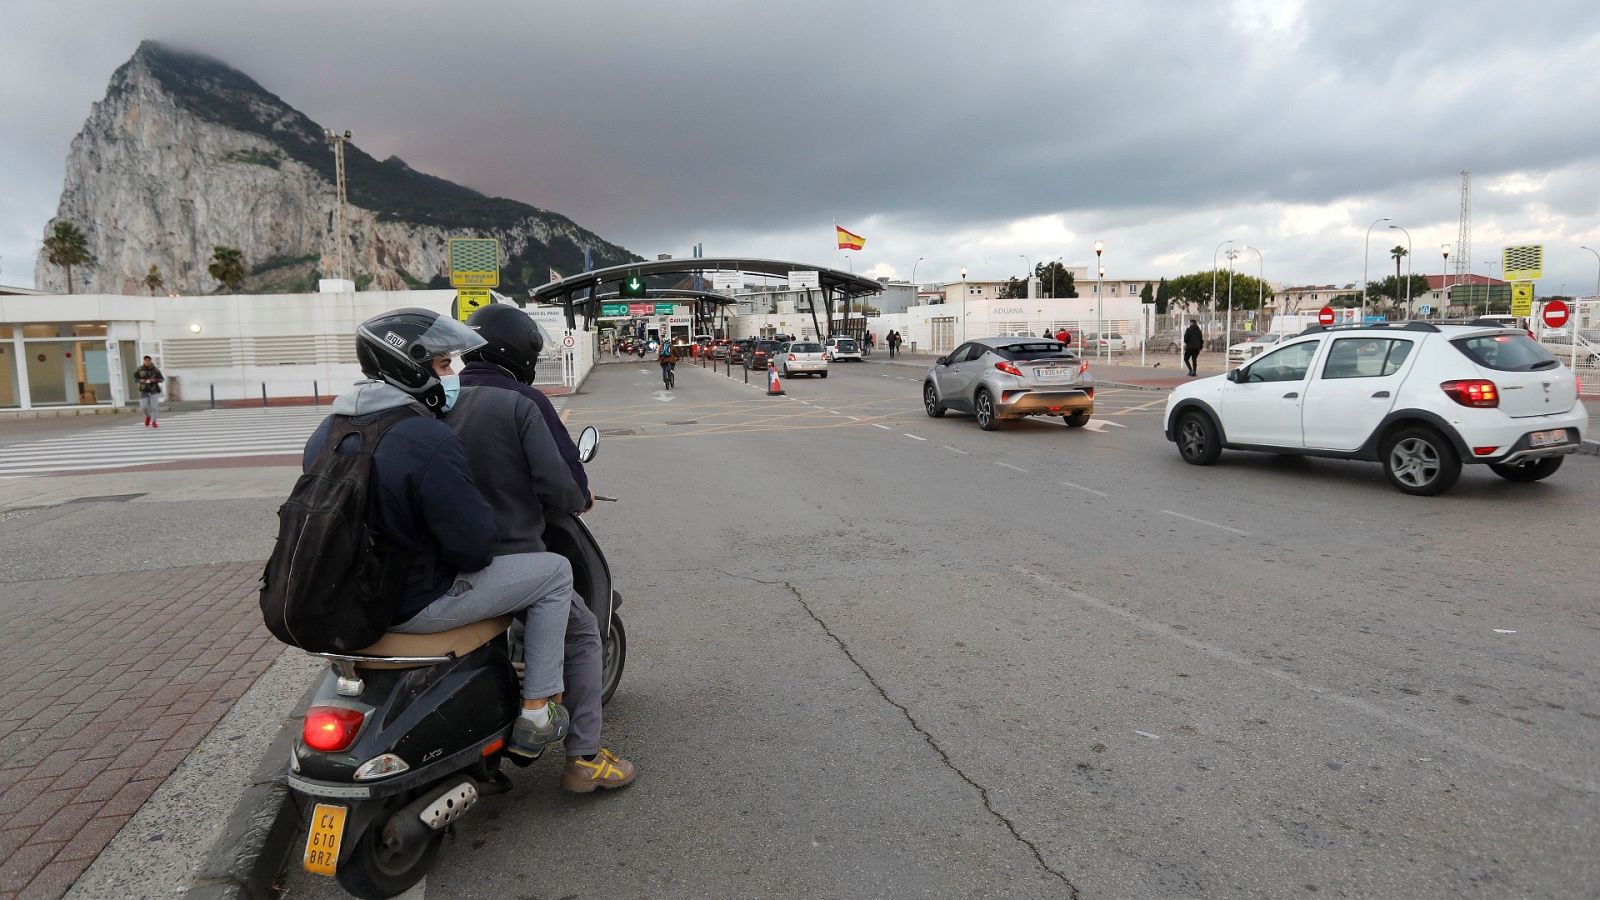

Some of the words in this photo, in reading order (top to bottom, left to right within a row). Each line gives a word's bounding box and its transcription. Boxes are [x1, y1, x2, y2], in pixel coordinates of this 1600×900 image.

[320, 814, 335, 829] C4
[313, 832, 336, 848] 610
[309, 849, 332, 866] BRZ
